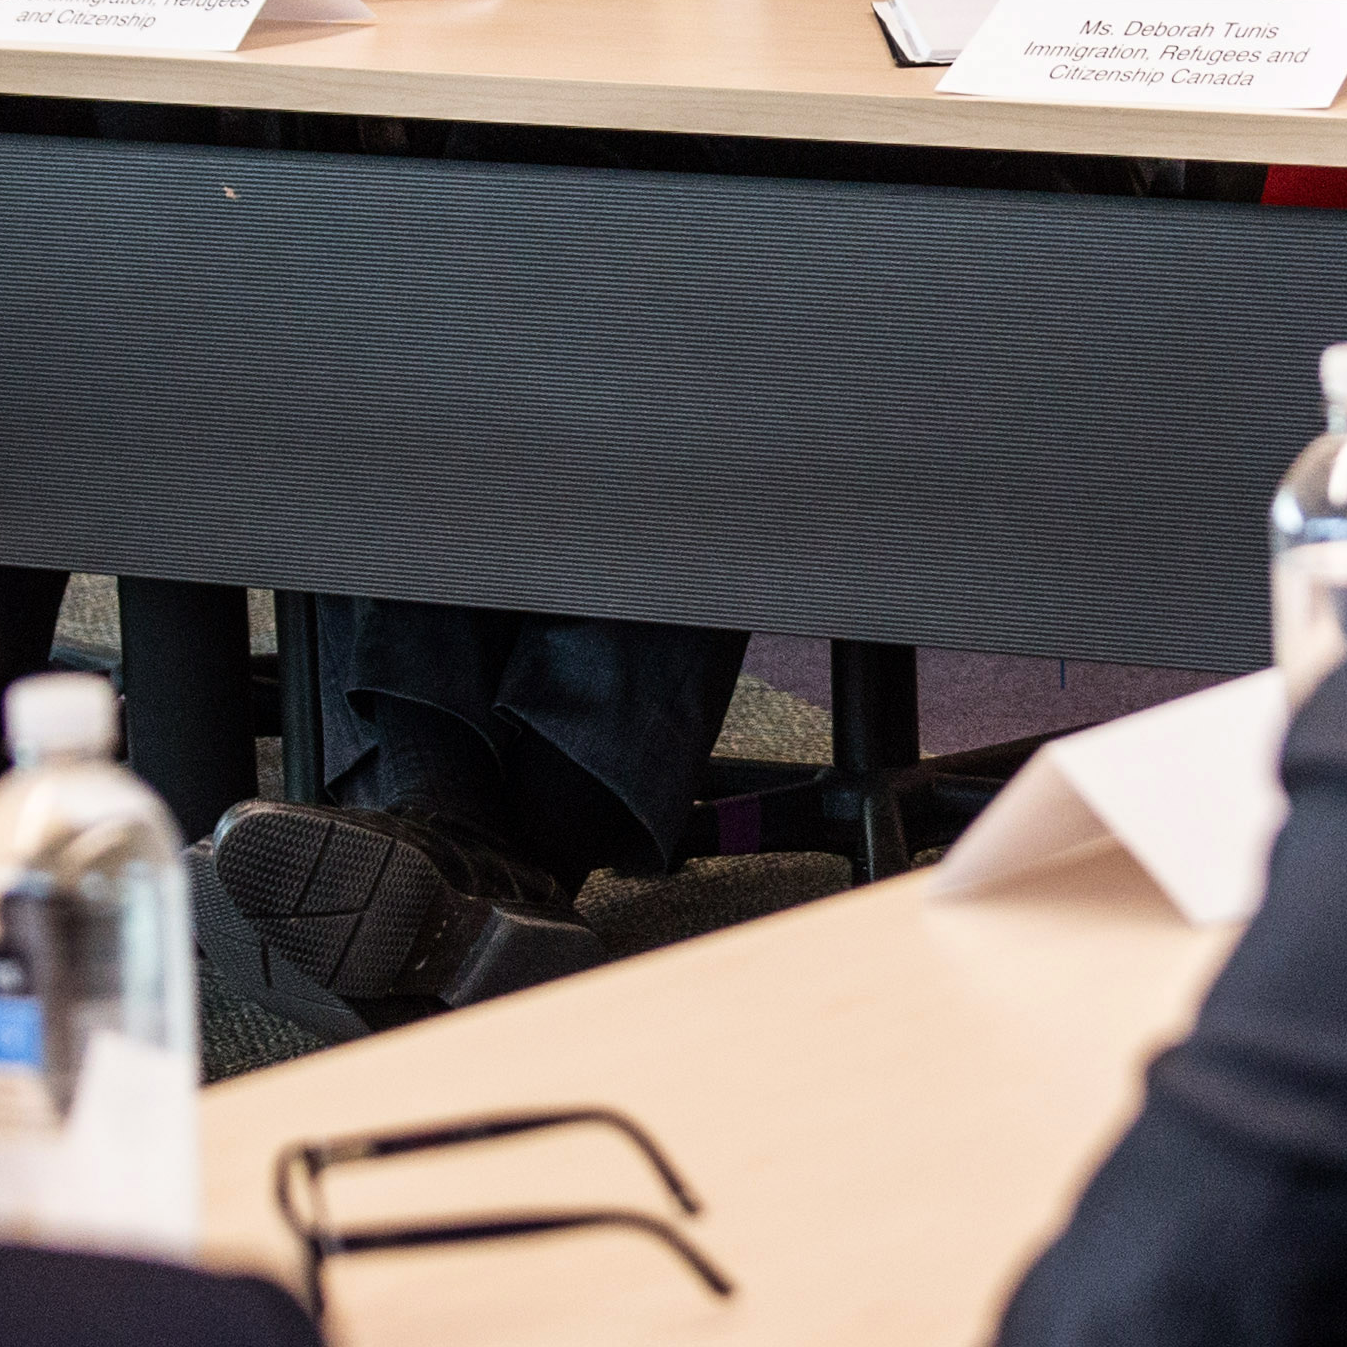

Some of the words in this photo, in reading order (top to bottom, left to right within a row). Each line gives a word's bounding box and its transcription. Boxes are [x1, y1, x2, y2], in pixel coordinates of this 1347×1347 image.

[15, 9, 54, 24] and
[56, 8, 157, 32] Citizenship
[1079, 19, 1114, 36] Ms.
[1123, 20, 1215, 38] Deborah
[1223, 21, 1280, 40] Tunis
[1023, 40, 1150, 63] Immigration,
[1158, 44, 1263, 66] Refugees
[1265, 47, 1311, 64] and
[1049, 63, 1166, 87] Citizenship
[1171, 67, 1255, 87] Canada
